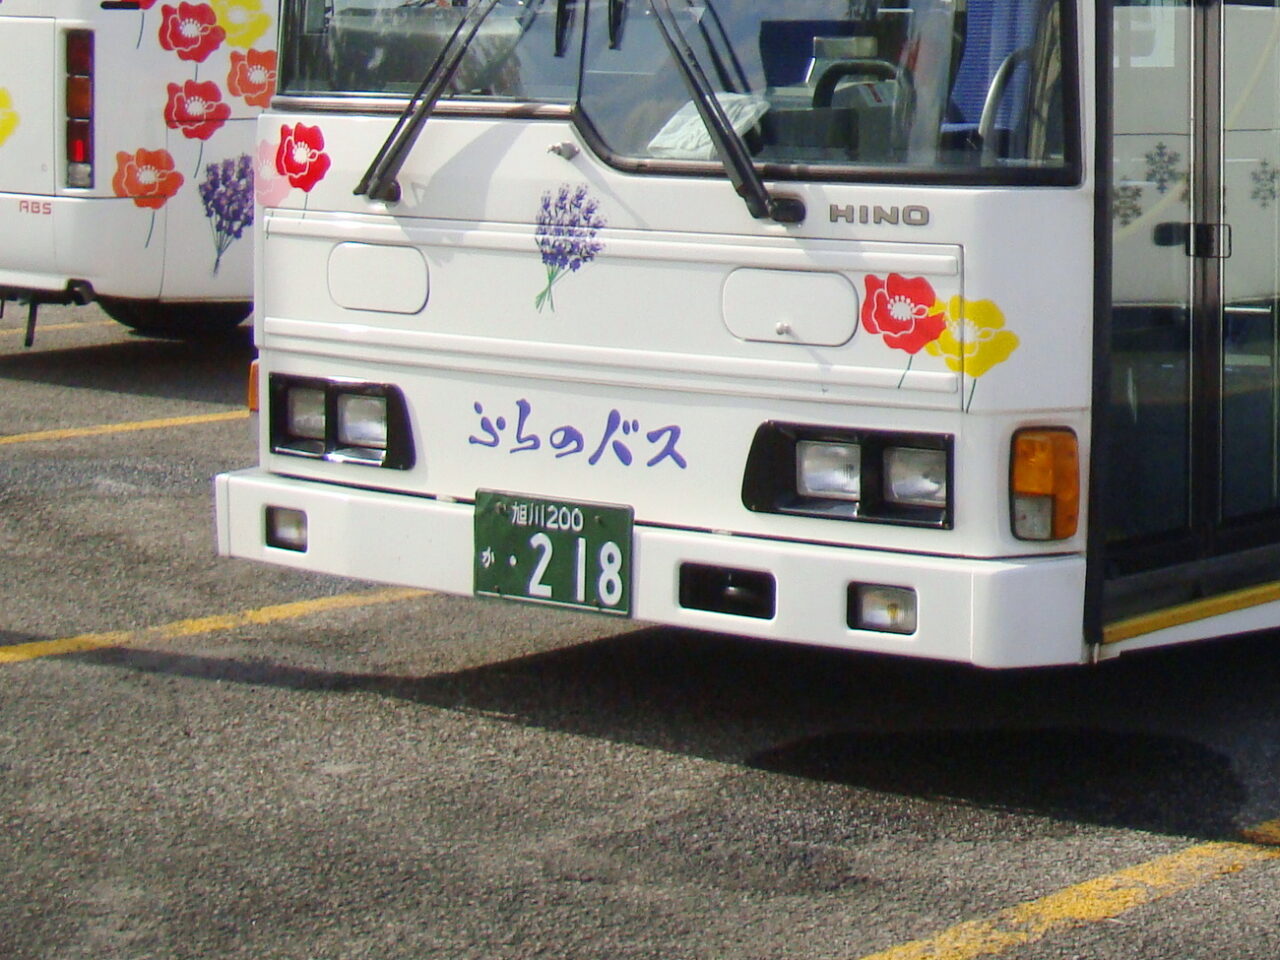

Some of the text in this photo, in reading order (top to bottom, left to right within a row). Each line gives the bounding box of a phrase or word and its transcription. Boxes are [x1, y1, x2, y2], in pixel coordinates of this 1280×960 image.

[19, 200, 52, 215] ABS
[829, 204, 930, 226] HINO
[468, 398, 688, 470] ふらのバス
